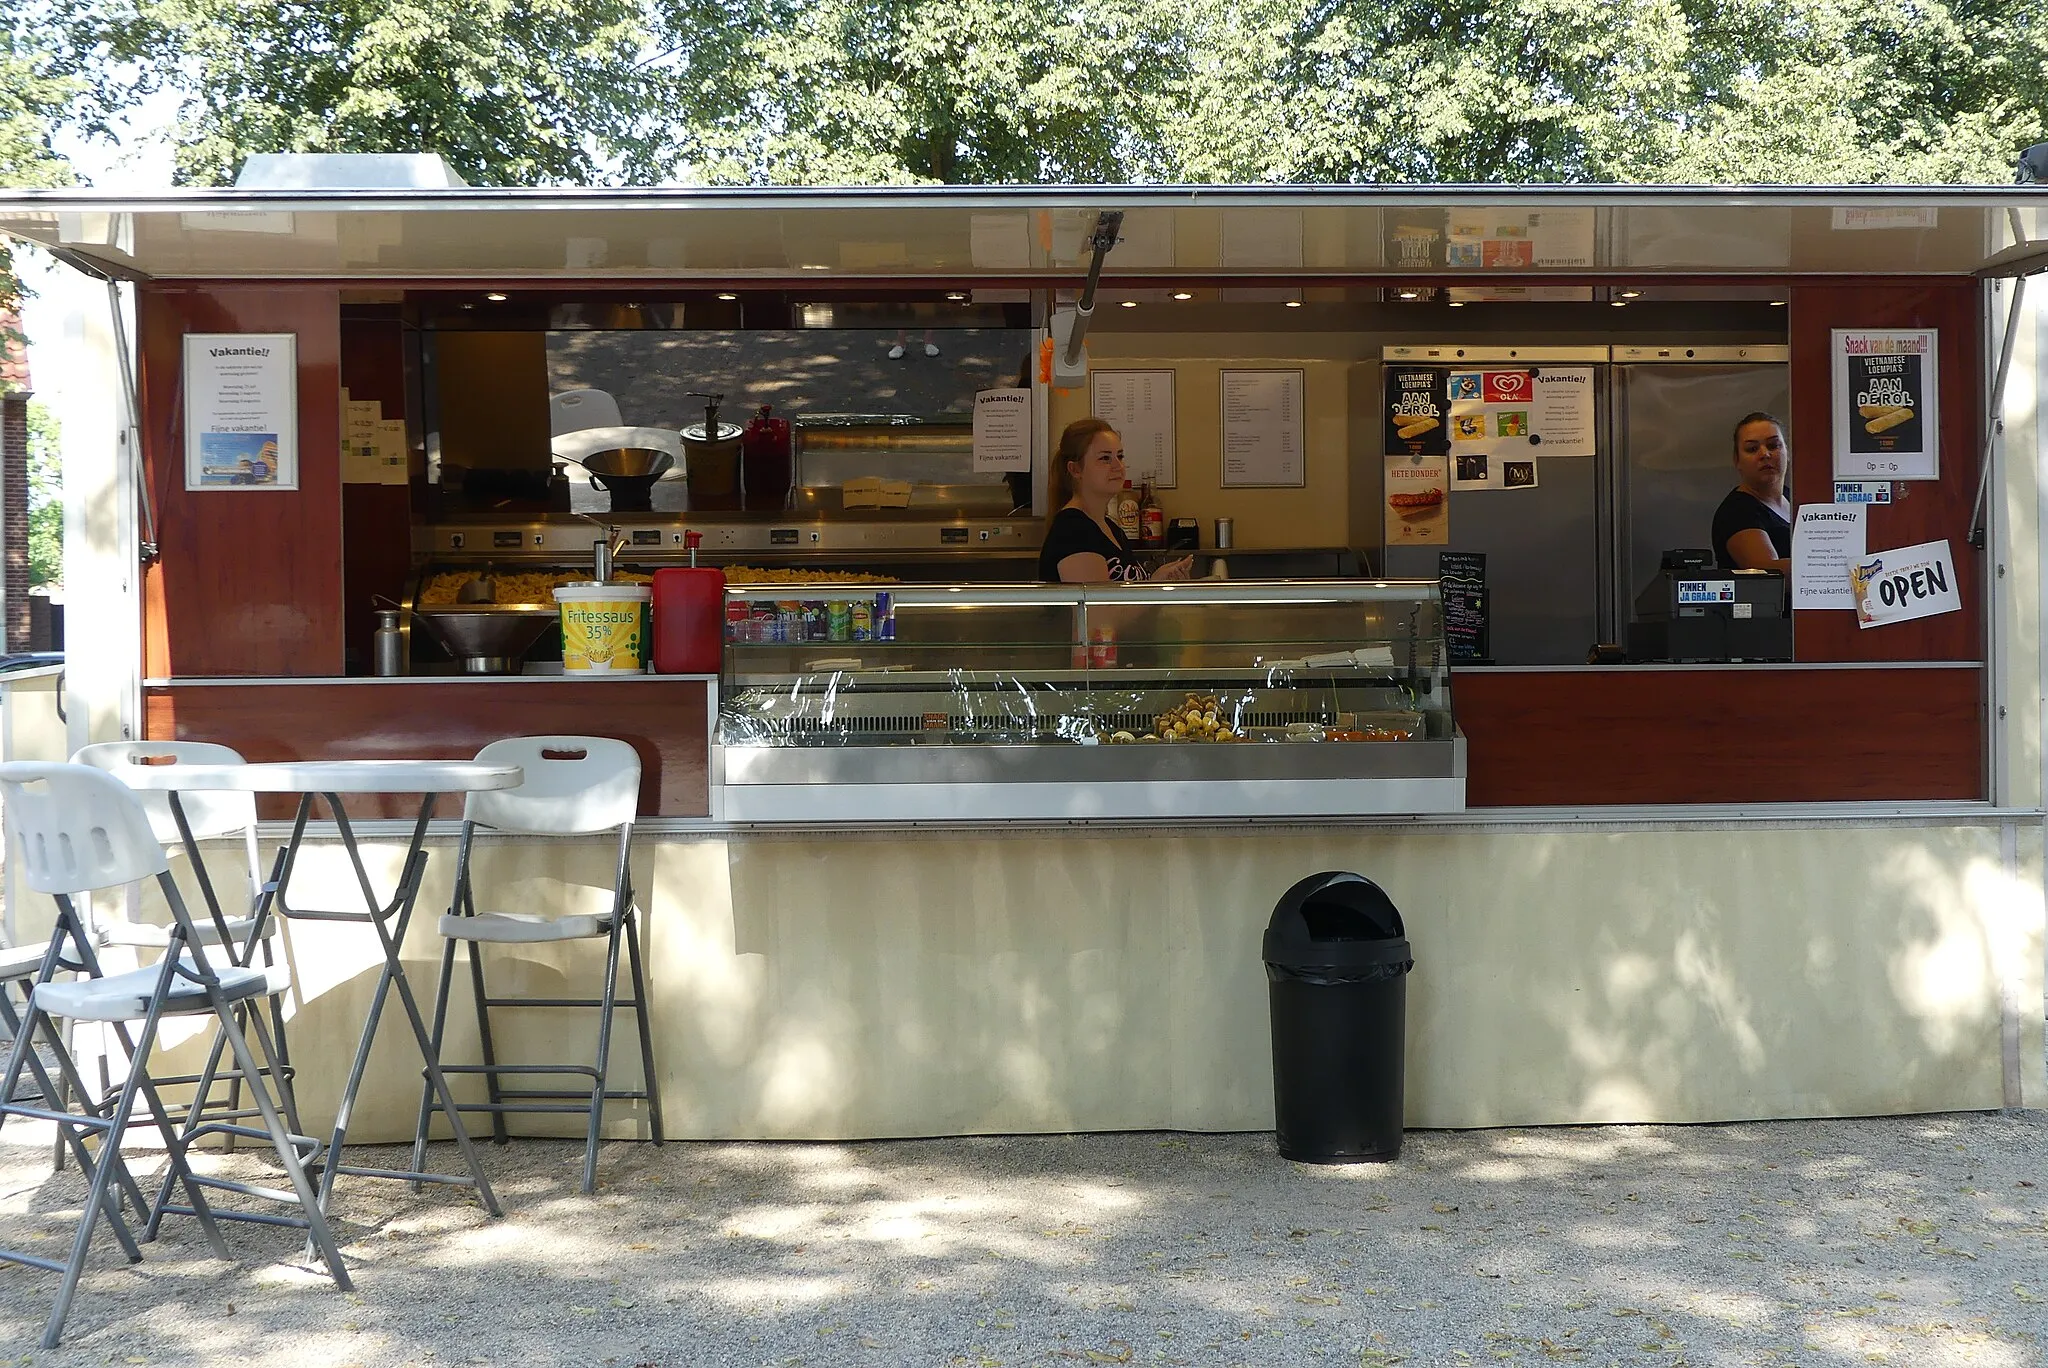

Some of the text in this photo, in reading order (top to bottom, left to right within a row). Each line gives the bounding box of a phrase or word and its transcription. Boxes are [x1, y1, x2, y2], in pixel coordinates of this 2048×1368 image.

[1845, 335, 1868, 354] Snack
[1870, 340, 1882, 354] van
[1885, 336, 1894, 354] de
[209, 346, 270, 358] Vakantie!!
[1864, 355, 1906, 367] VIETNAMESE
[1868, 364, 1904, 375] LOEMPIA'S
[1398, 373, 1434, 382] VIETNAMESE
[1538, 375, 1587, 384] Vakantie!!
[1401, 381, 1432, 389] LOEMPIA'S
[1869, 378, 1902, 393] AAN
[979, 395, 1025, 404] Vakantie!!
[1401, 391, 1431, 405] AAN
[1500, 393, 1520, 401] OLA
[211, 424, 268, 433] Fijne vakantie!
[979, 455, 994, 463] Fijne
[1866, 462, 1877, 471] Op
[1889, 462, 1899, 472] Op
[1391, 469, 1410, 478] HETE
[1835, 483, 1863, 493] PINNEN
[1835, 493, 1873, 503] JA GRAAG
[1801, 512, 1857, 522] Vakantie!!
[1680, 583, 1707, 592] PINNEN
[1880, 560, 1949, 608] OPEN
[1800, 586, 1853, 597] Fijne vakantie!
[1680, 592, 1717, 602] JA GRAAG
[568, 609, 635, 624] Fritessaus
[586, 625, 612, 640] 35%
